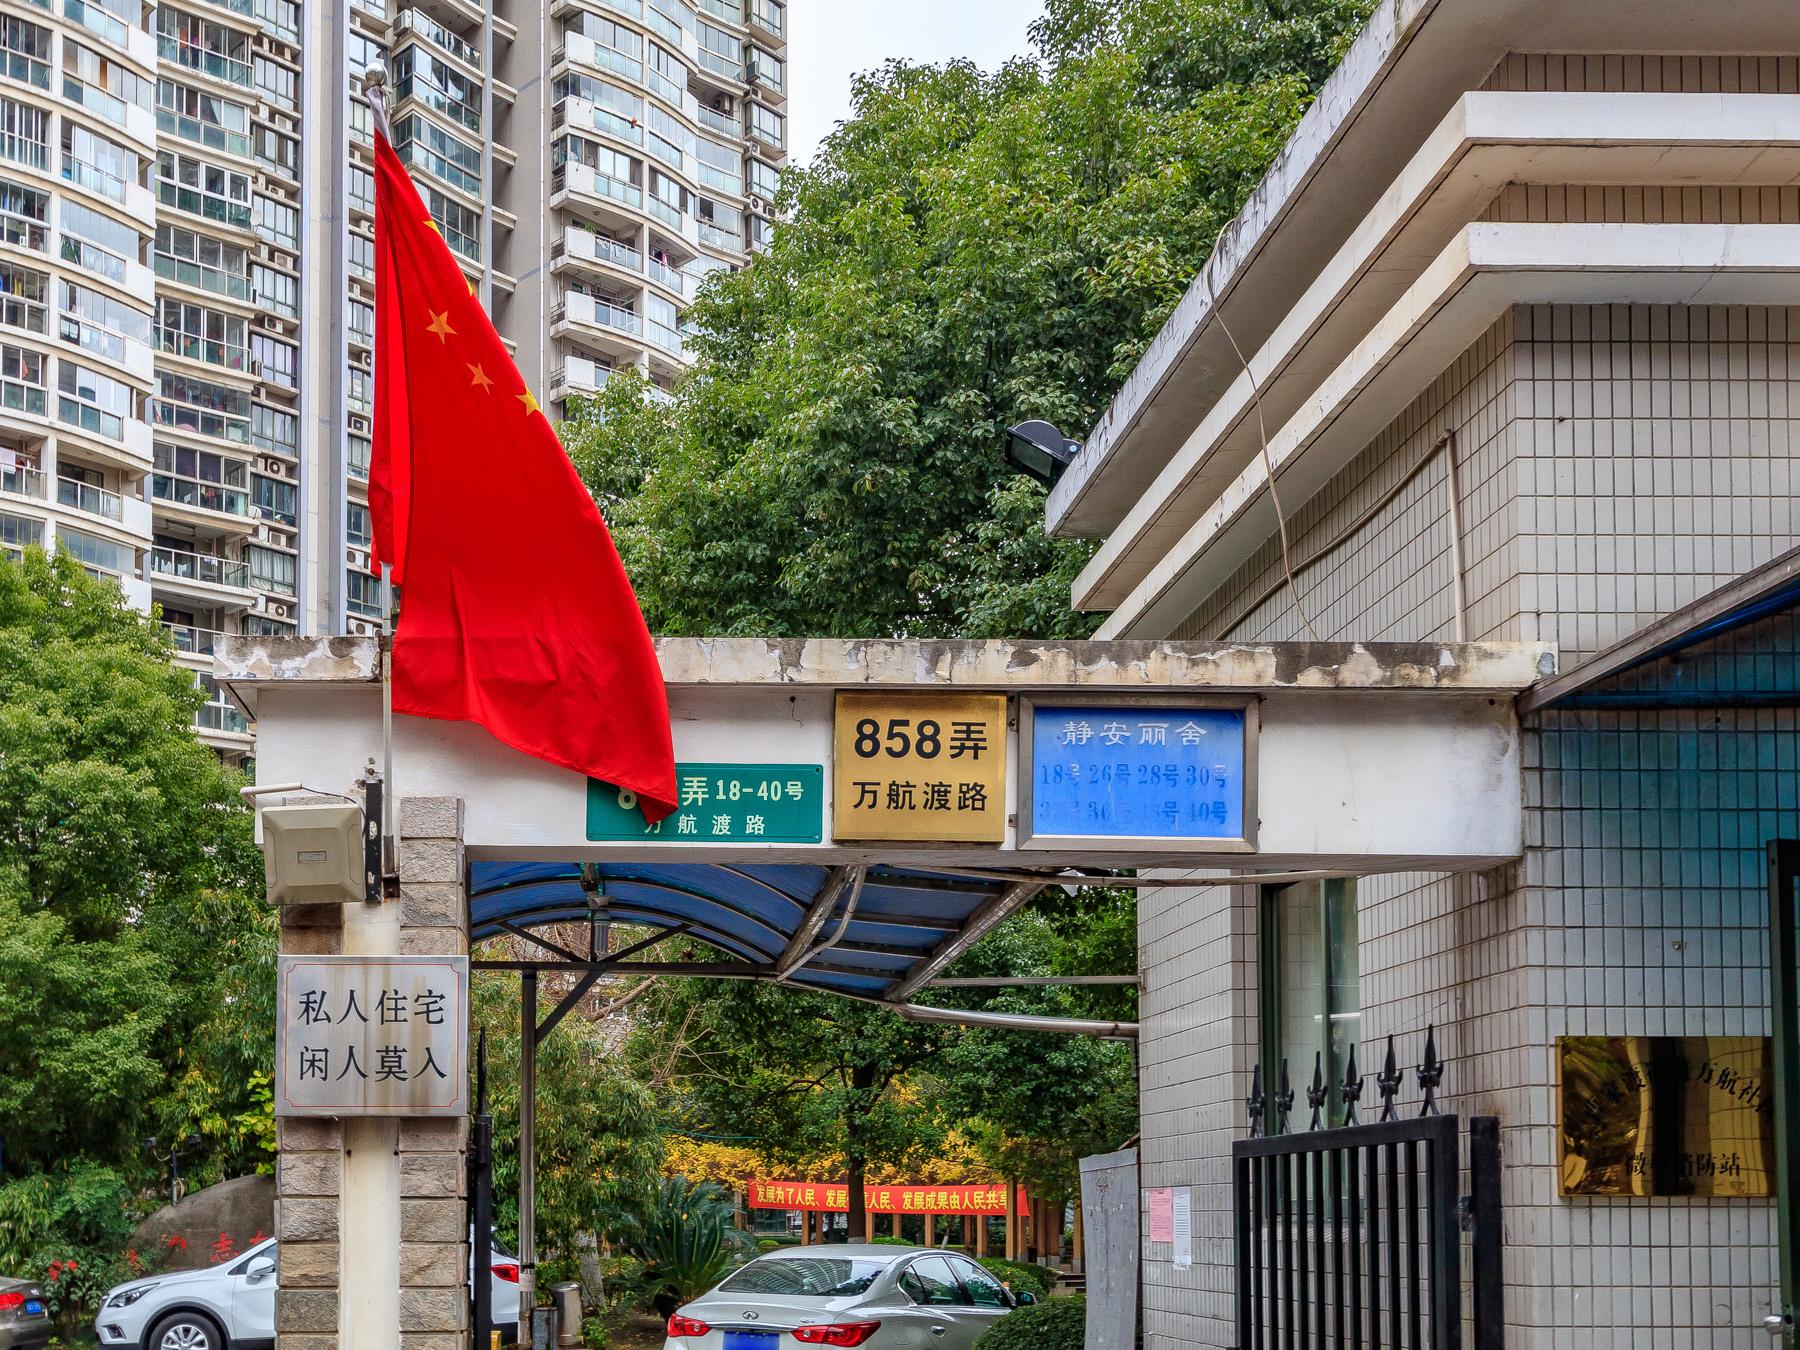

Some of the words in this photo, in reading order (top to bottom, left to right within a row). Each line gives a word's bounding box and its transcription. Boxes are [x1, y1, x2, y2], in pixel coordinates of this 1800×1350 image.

[854, 718, 988, 760] 858弄
[1061, 720, 1208, 746] 静安丽舍
[1137, 763, 1180, 788] 28号
[1186, 764, 1229, 788] 30号
[852, 780, 988, 812] 万航渡路
[297, 988, 447, 1026] 私人住宅
[299, 1045, 448, 1083] 闲人莫入
